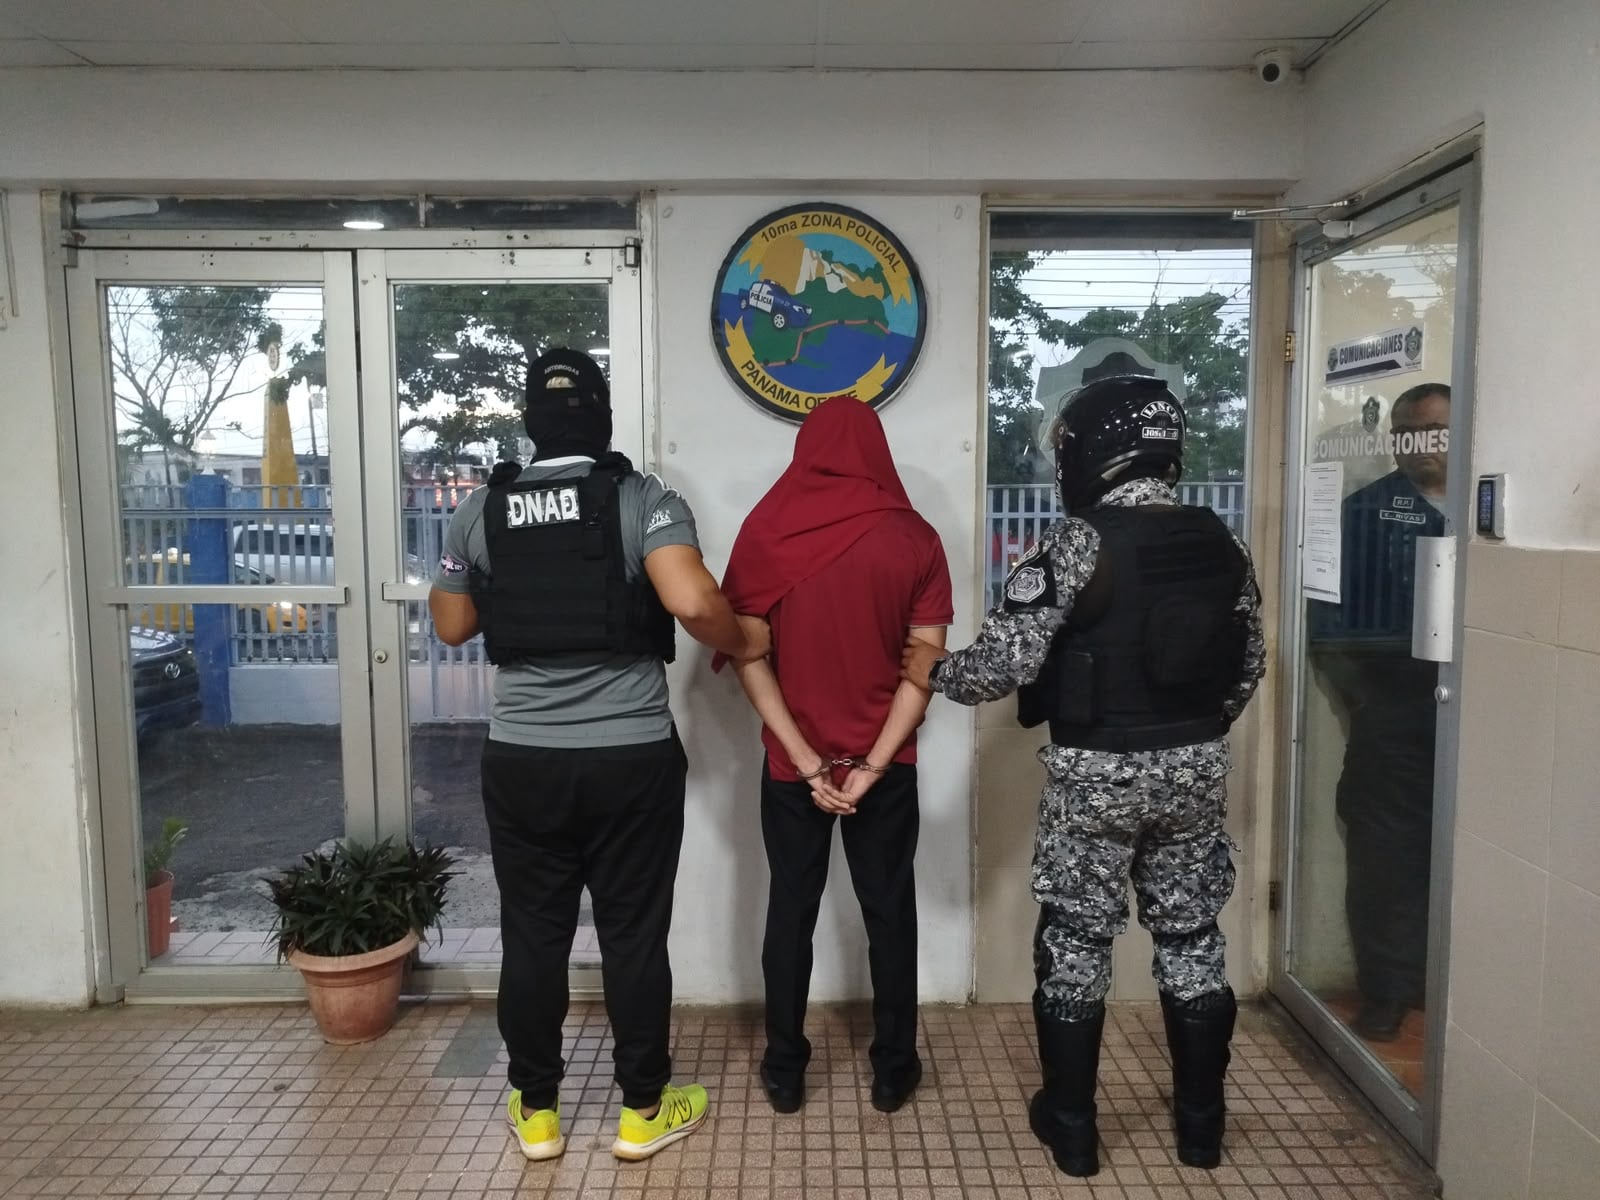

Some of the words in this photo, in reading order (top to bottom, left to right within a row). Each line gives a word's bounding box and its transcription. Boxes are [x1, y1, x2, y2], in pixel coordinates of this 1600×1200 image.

[761, 220, 798, 243] 10ma
[801, 214, 842, 229] ZONA
[845, 219, 903, 273] POLICIAL
[1339, 333, 1403, 366] COMUNICACIONES
[741, 359, 800, 409] PANAMA
[1311, 428, 1449, 459] COMUNICACIONES
[508, 488, 578, 526] DNAD
